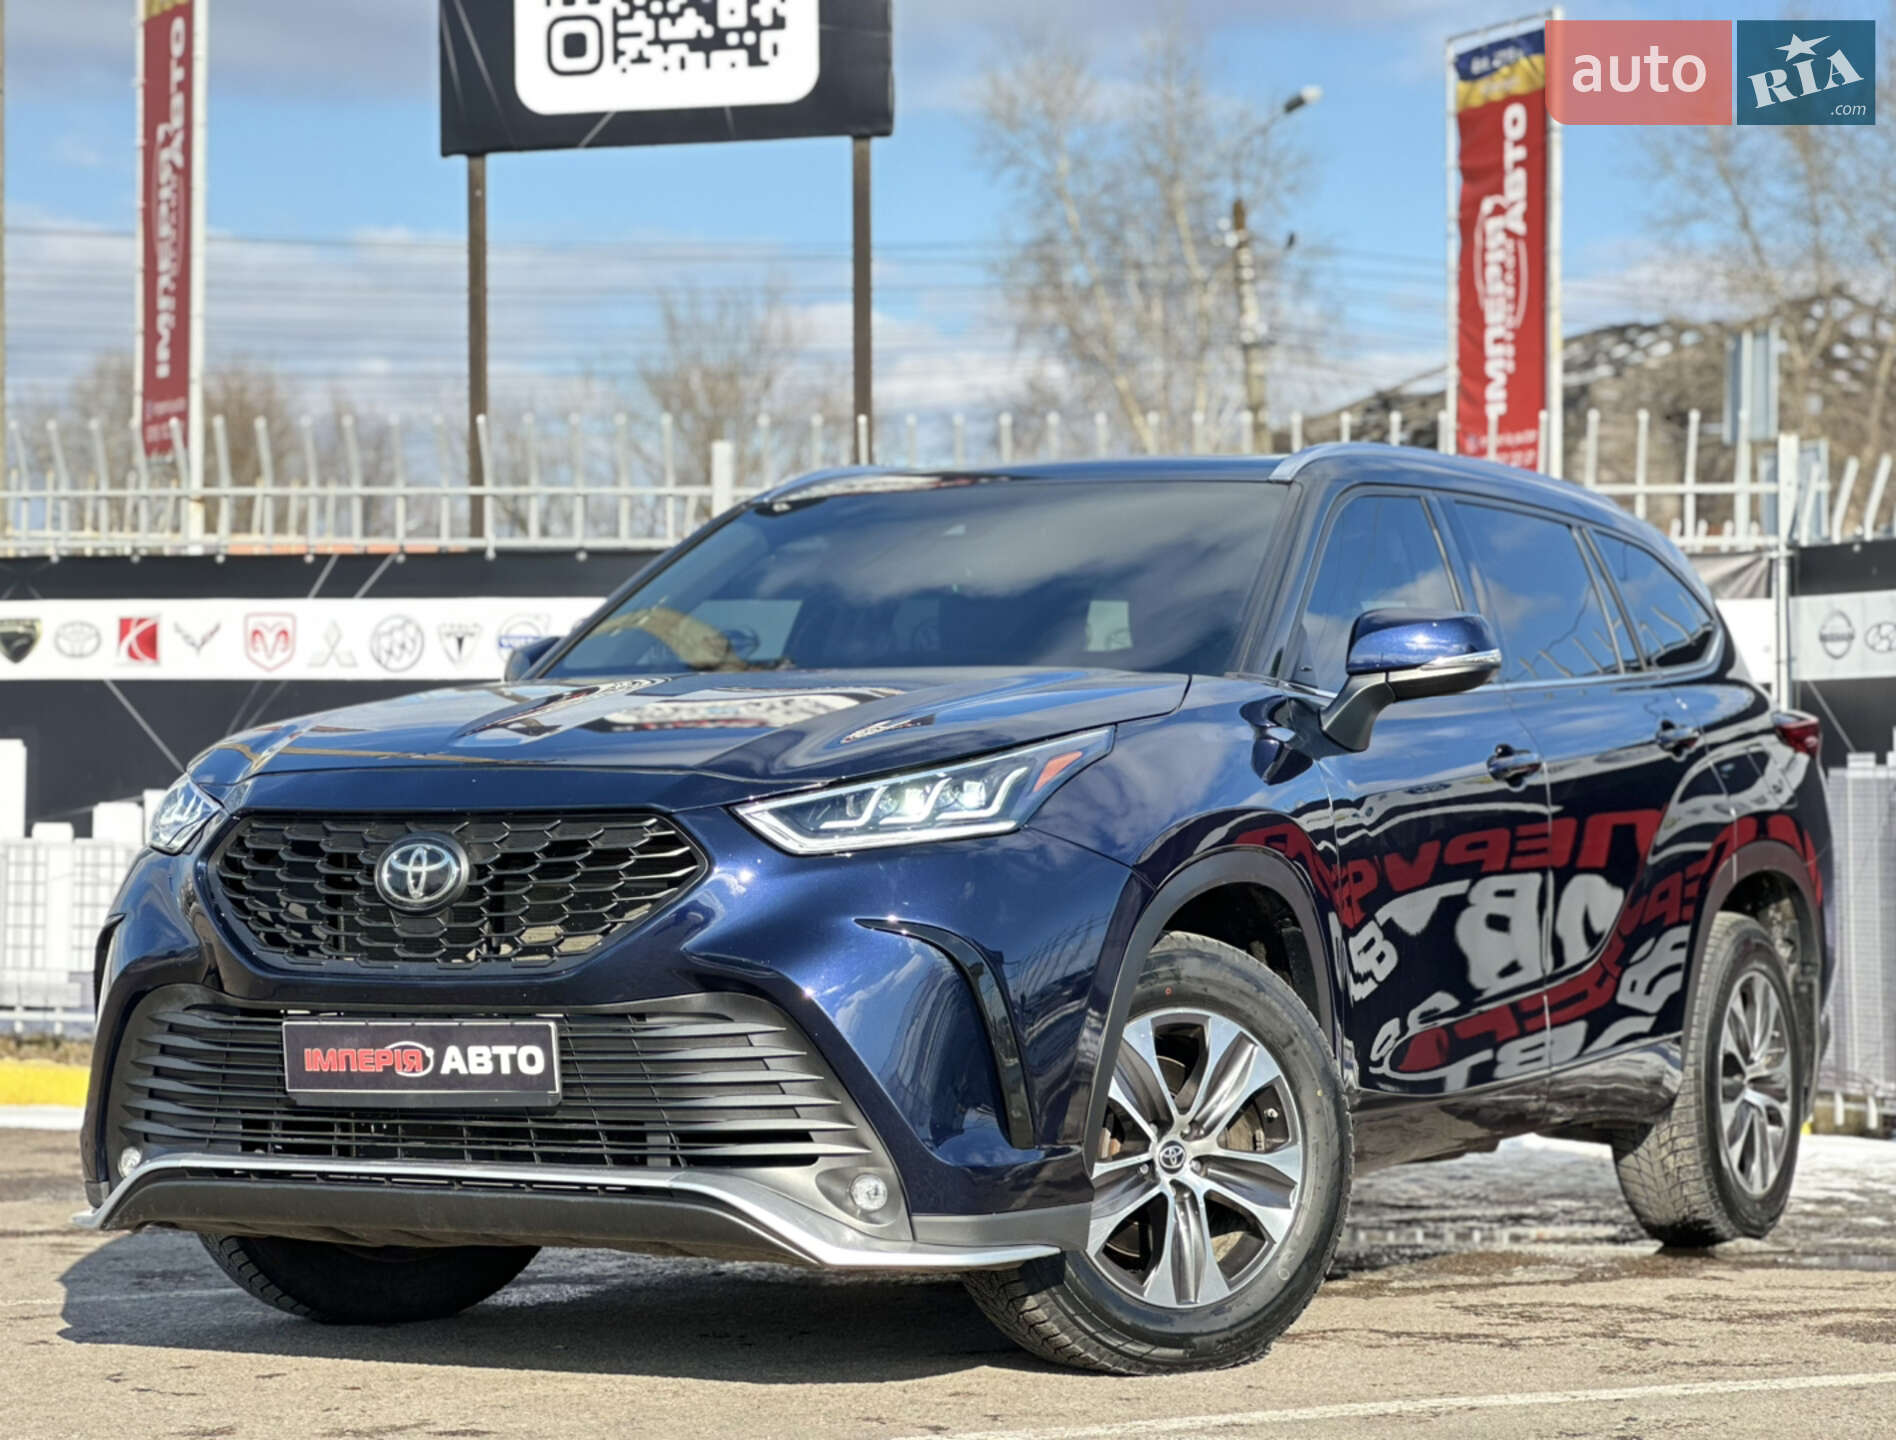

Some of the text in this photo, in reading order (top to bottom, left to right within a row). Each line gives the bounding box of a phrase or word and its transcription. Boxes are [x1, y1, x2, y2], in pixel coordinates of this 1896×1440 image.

[1503, 102, 1528, 237] АВТО
[303, 1044, 546, 1075] ІМПЕРІЯ АВТО
